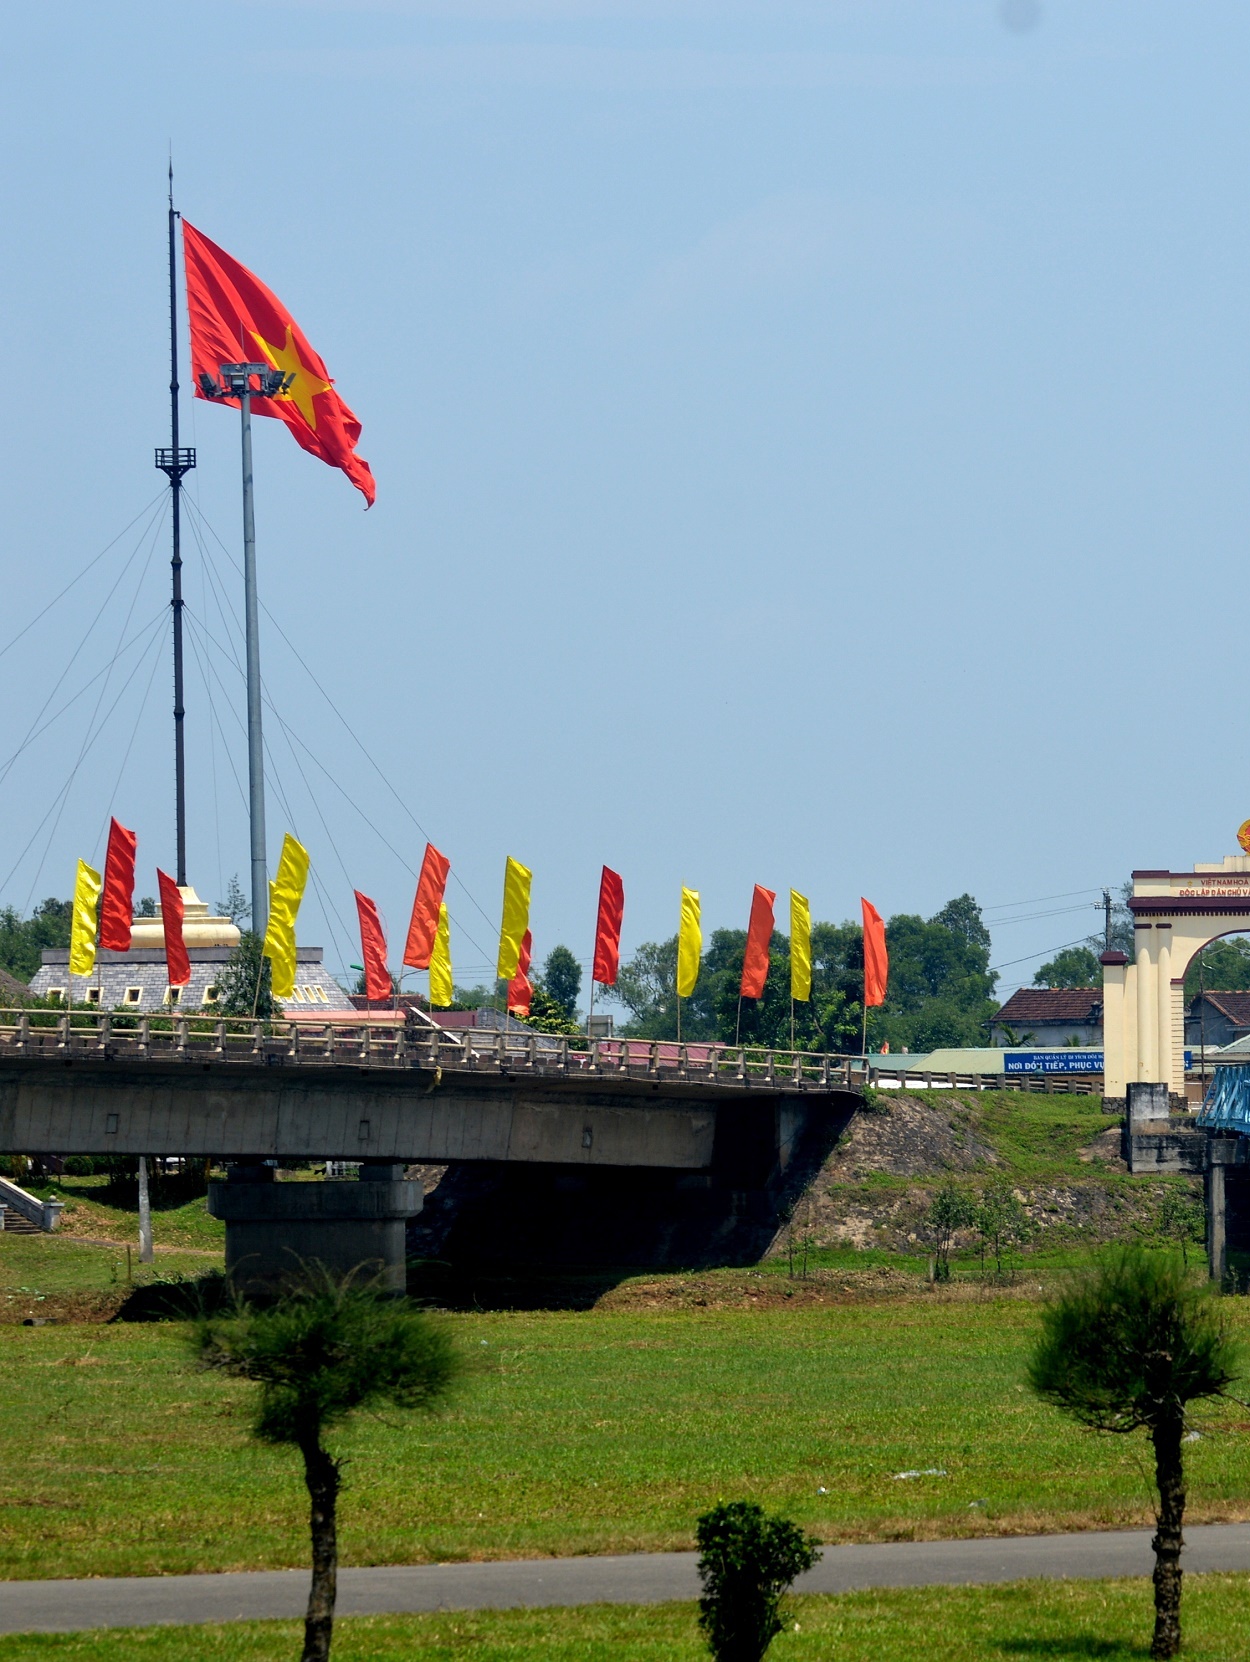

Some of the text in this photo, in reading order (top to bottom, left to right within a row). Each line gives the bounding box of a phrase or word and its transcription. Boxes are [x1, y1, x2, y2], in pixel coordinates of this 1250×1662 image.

[1200, 878, 1216, 886] VIỆT
[1211, 887, 1226, 896] DÂN
[1044, 1060, 1067, 1070] TIẾP,
[1069, 1062, 1092, 1070] PHỤC
